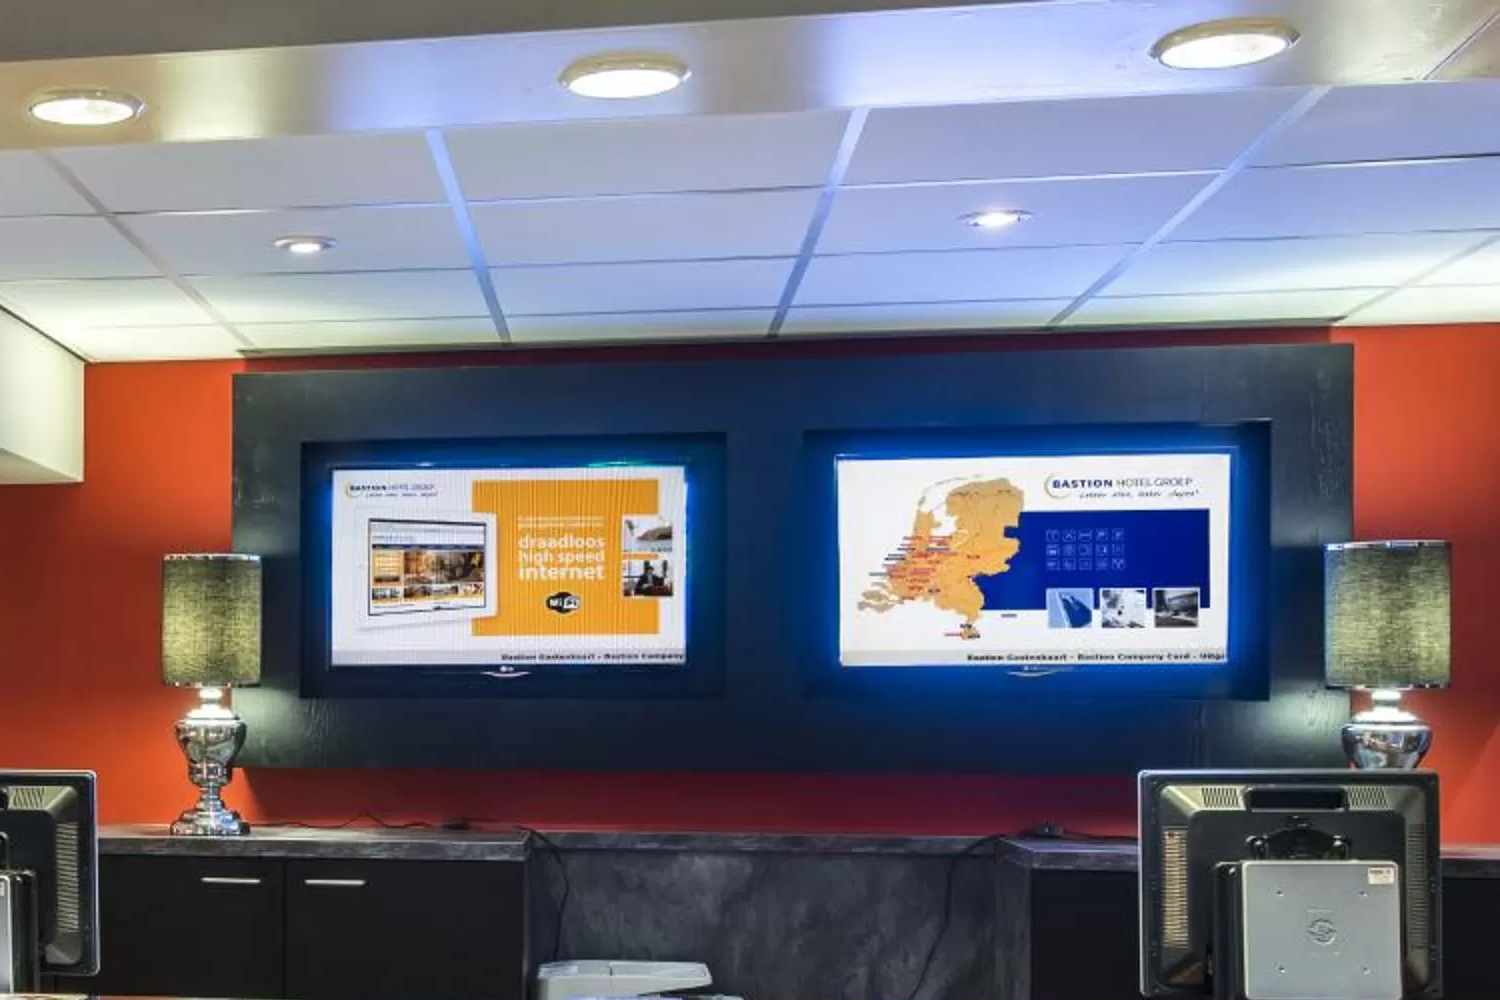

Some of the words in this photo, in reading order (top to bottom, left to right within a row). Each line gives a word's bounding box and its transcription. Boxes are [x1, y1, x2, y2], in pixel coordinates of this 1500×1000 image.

[1052, 478, 1113, 489] BASTION
[1116, 478, 1152, 487] HOTEL
[1154, 477, 1193, 487] GROEP
[518, 535, 604, 549] draadloos
[518, 549, 553, 567] high
[558, 549, 605, 567] speed
[518, 563, 605, 580] internet
[1118, 653, 1162, 662] Company
